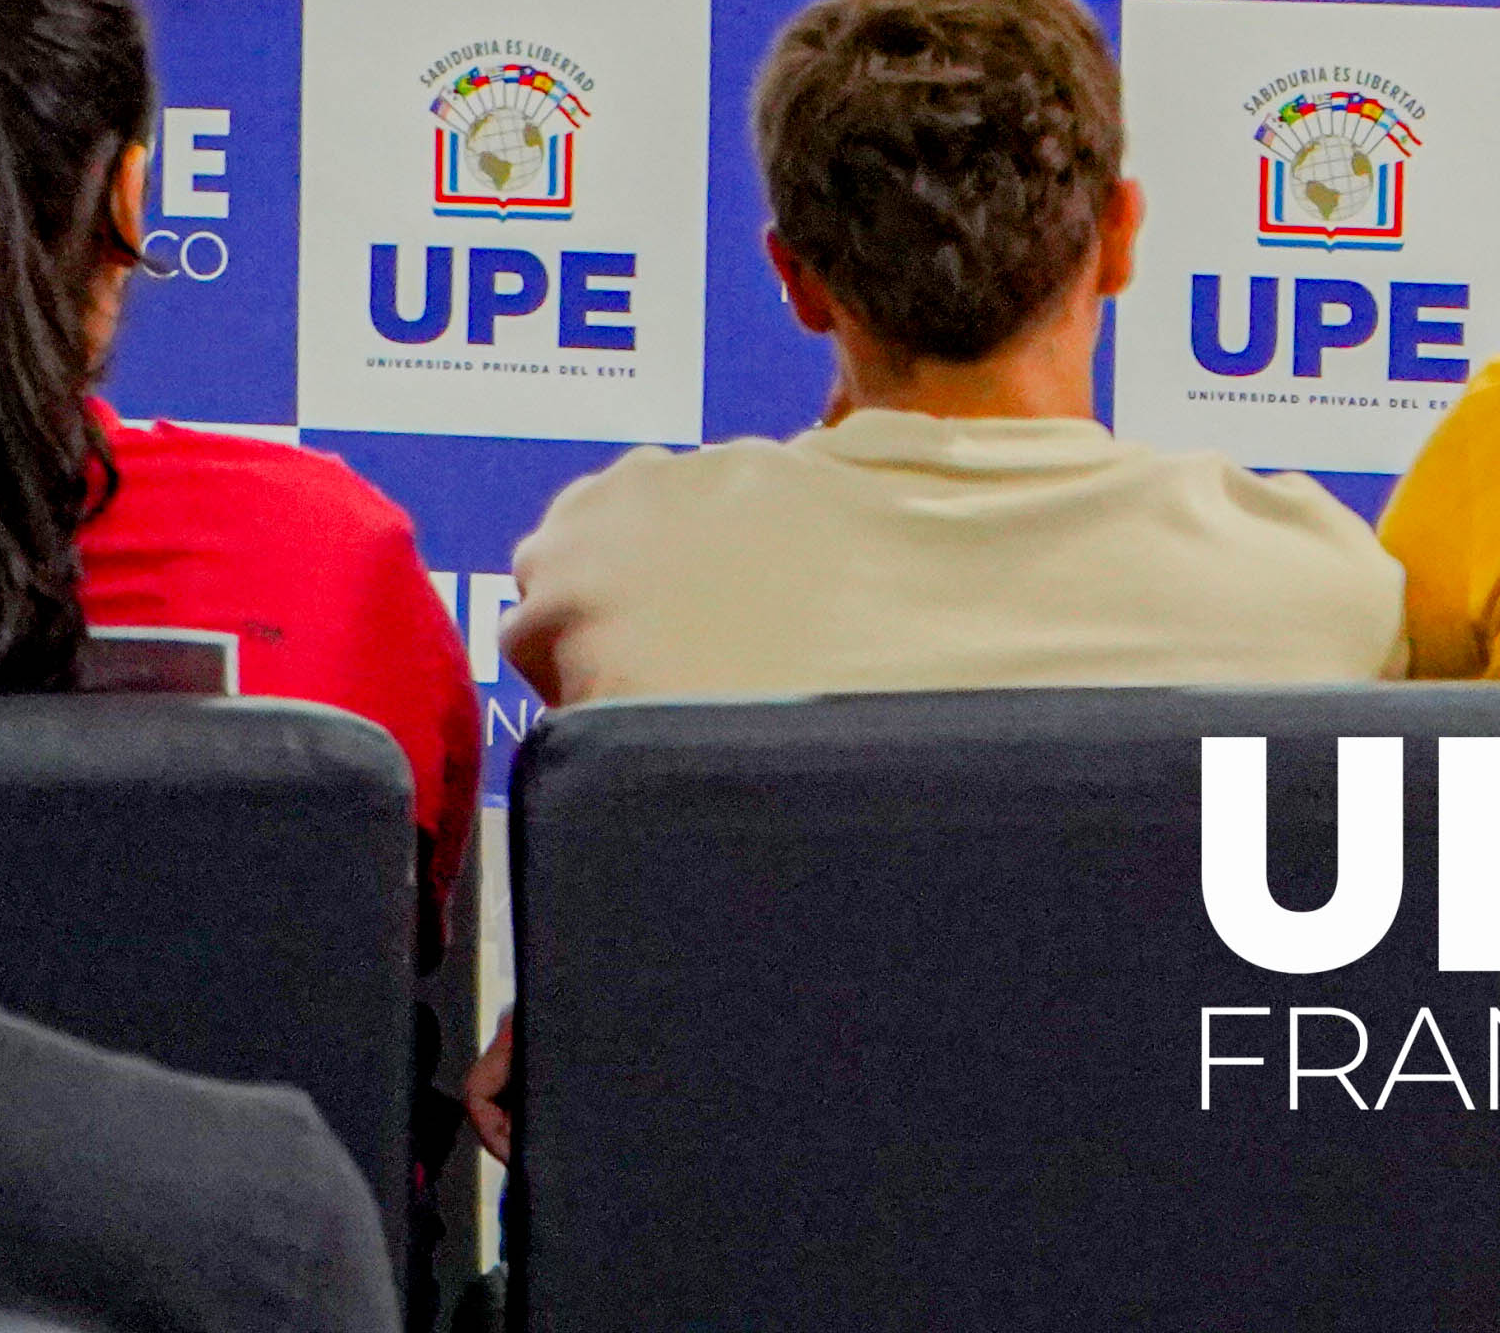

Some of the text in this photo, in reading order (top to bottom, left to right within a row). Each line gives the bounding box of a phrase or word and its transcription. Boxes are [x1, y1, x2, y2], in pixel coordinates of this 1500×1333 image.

[1243, 66, 1426, 120] SABIDURIA ES LIBERTAD
[370, 244, 636, 350] UPE
[1191, 274, 1469, 383] UPE
